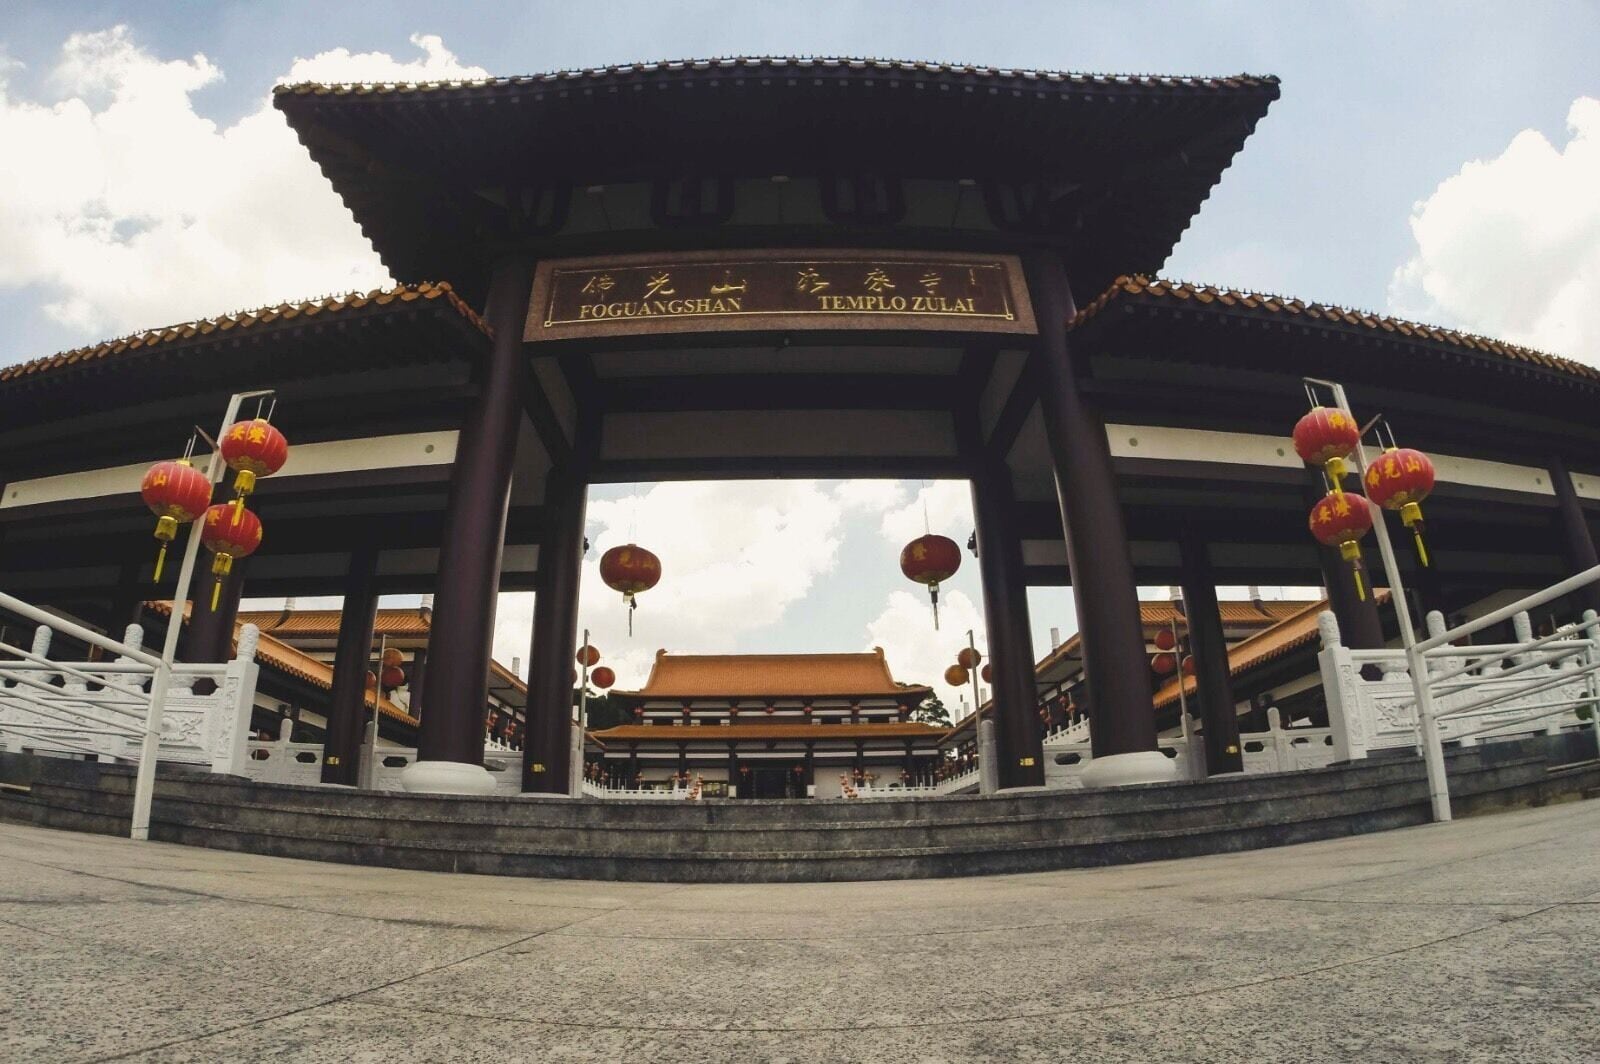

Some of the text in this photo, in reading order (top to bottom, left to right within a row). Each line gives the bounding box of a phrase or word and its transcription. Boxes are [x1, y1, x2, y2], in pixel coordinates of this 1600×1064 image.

[578, 297, 742, 319] FOGUANGSHAN
[818, 295, 976, 313] TEMPLO ZULAI
